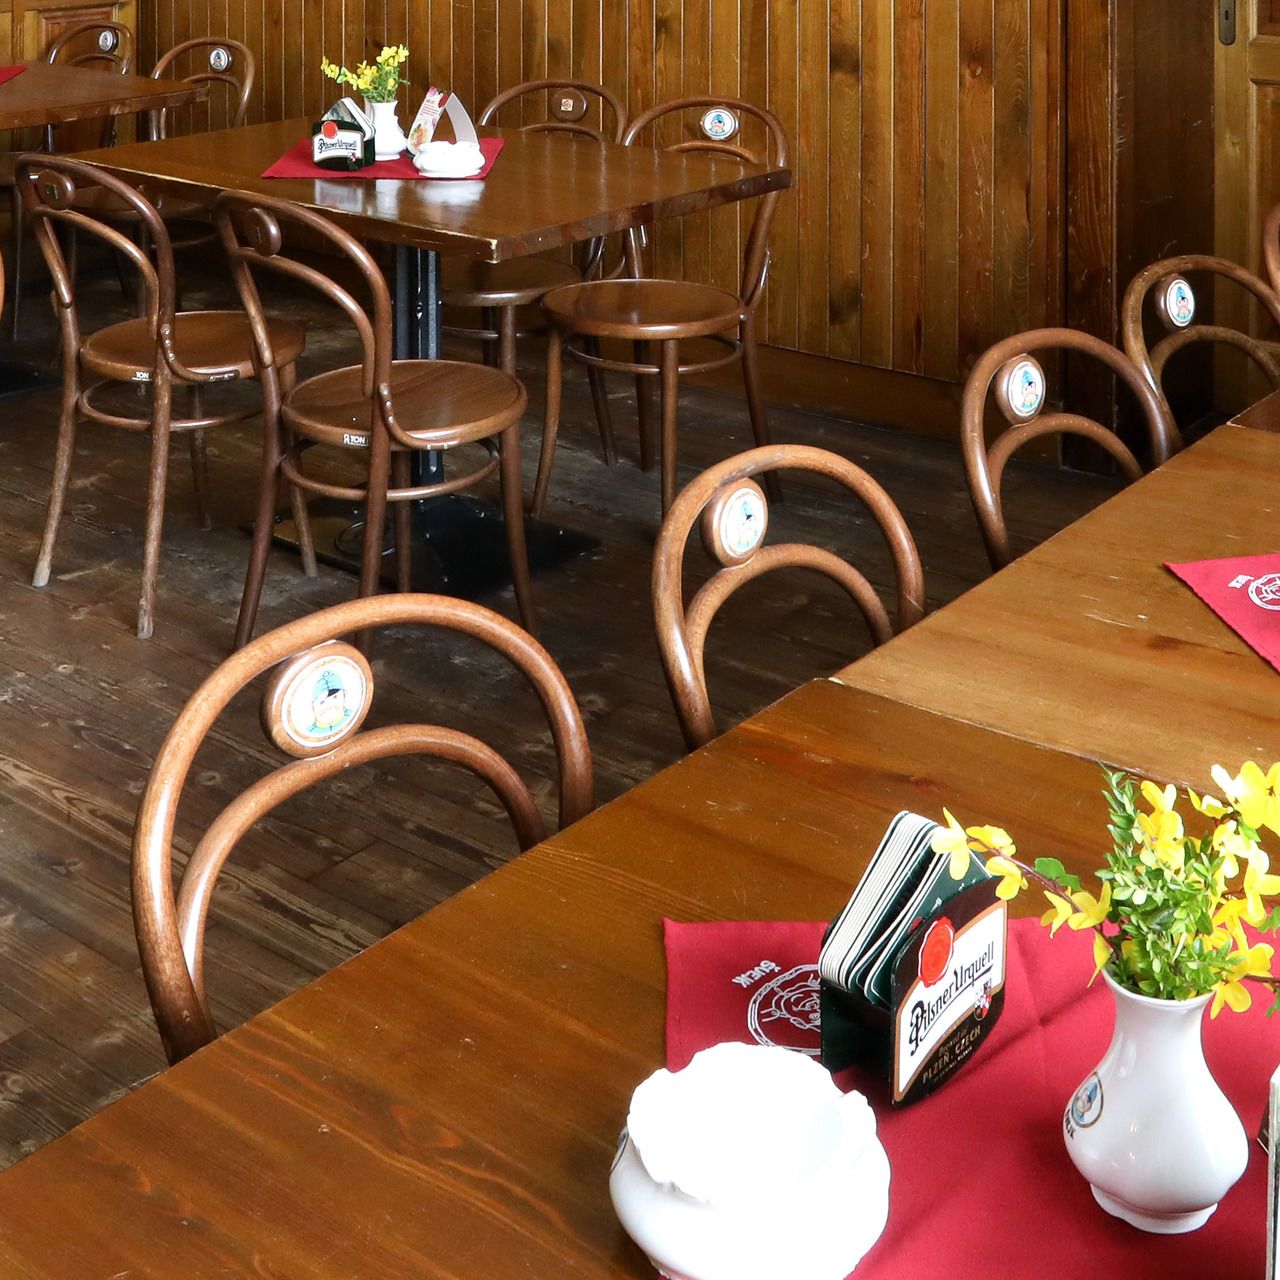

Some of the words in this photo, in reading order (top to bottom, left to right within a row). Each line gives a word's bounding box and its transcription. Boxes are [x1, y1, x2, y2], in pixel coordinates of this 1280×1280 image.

[909, 983, 954, 1057] Pilsner
[953, 941, 994, 992] Urquell
[922, 1051, 951, 1084] PLZEŇ
[955, 1025, 981, 1055] CZECH
